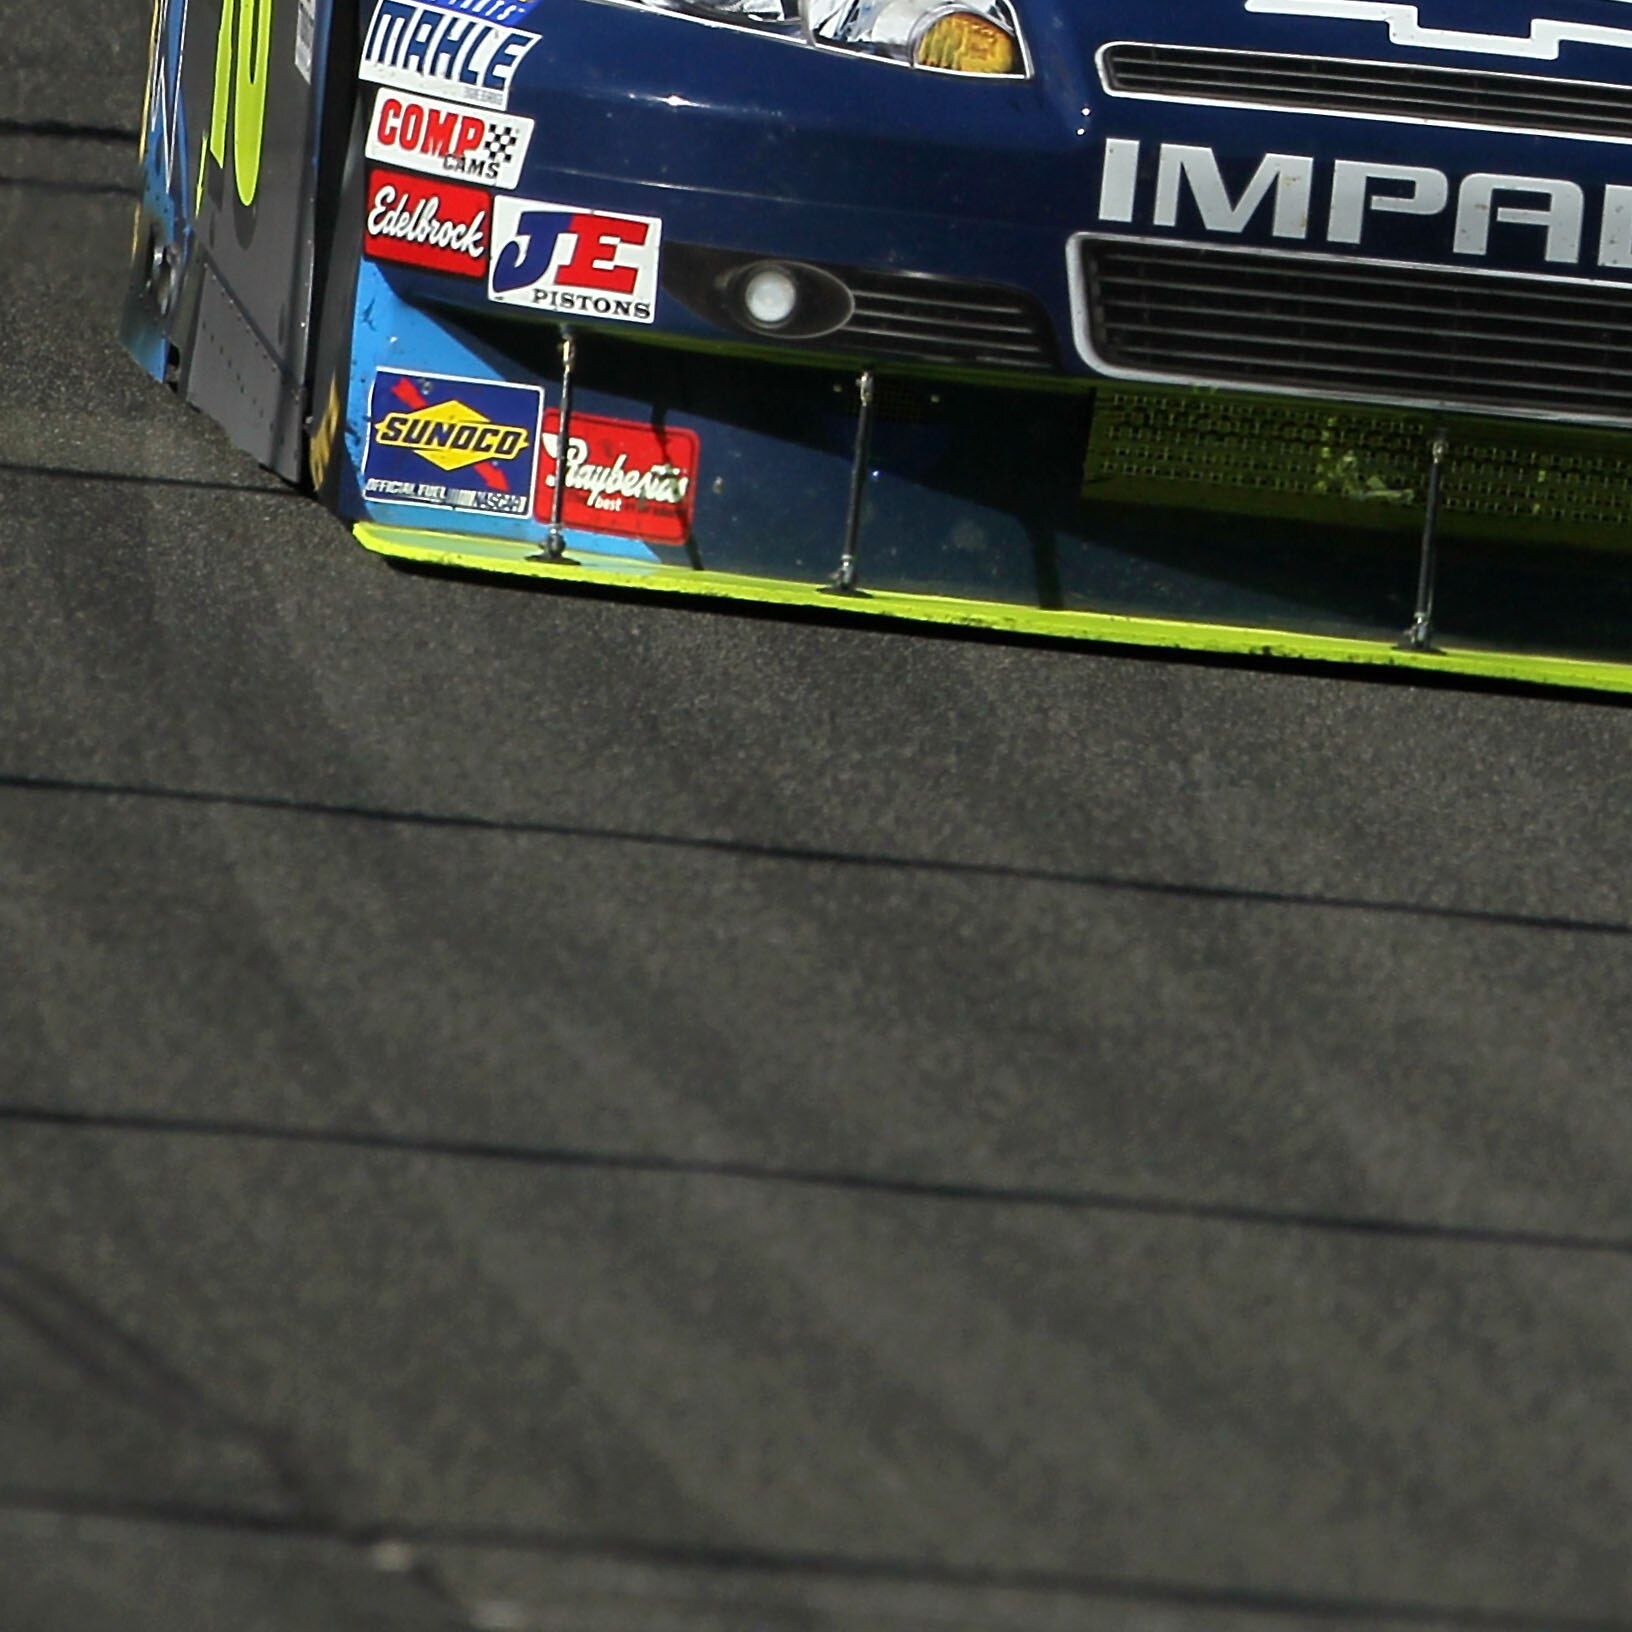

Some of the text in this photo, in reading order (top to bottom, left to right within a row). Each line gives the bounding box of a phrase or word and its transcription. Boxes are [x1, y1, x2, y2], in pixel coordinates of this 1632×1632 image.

[377, 98, 485, 159] COMP
[442, 153, 500, 180] CAMS
[367, 185, 485, 259] Edelbrock
[492, 210, 650, 295] JE
[532, 288, 651, 320] PISTONS
[380, 416, 522, 456] SUNOCO
